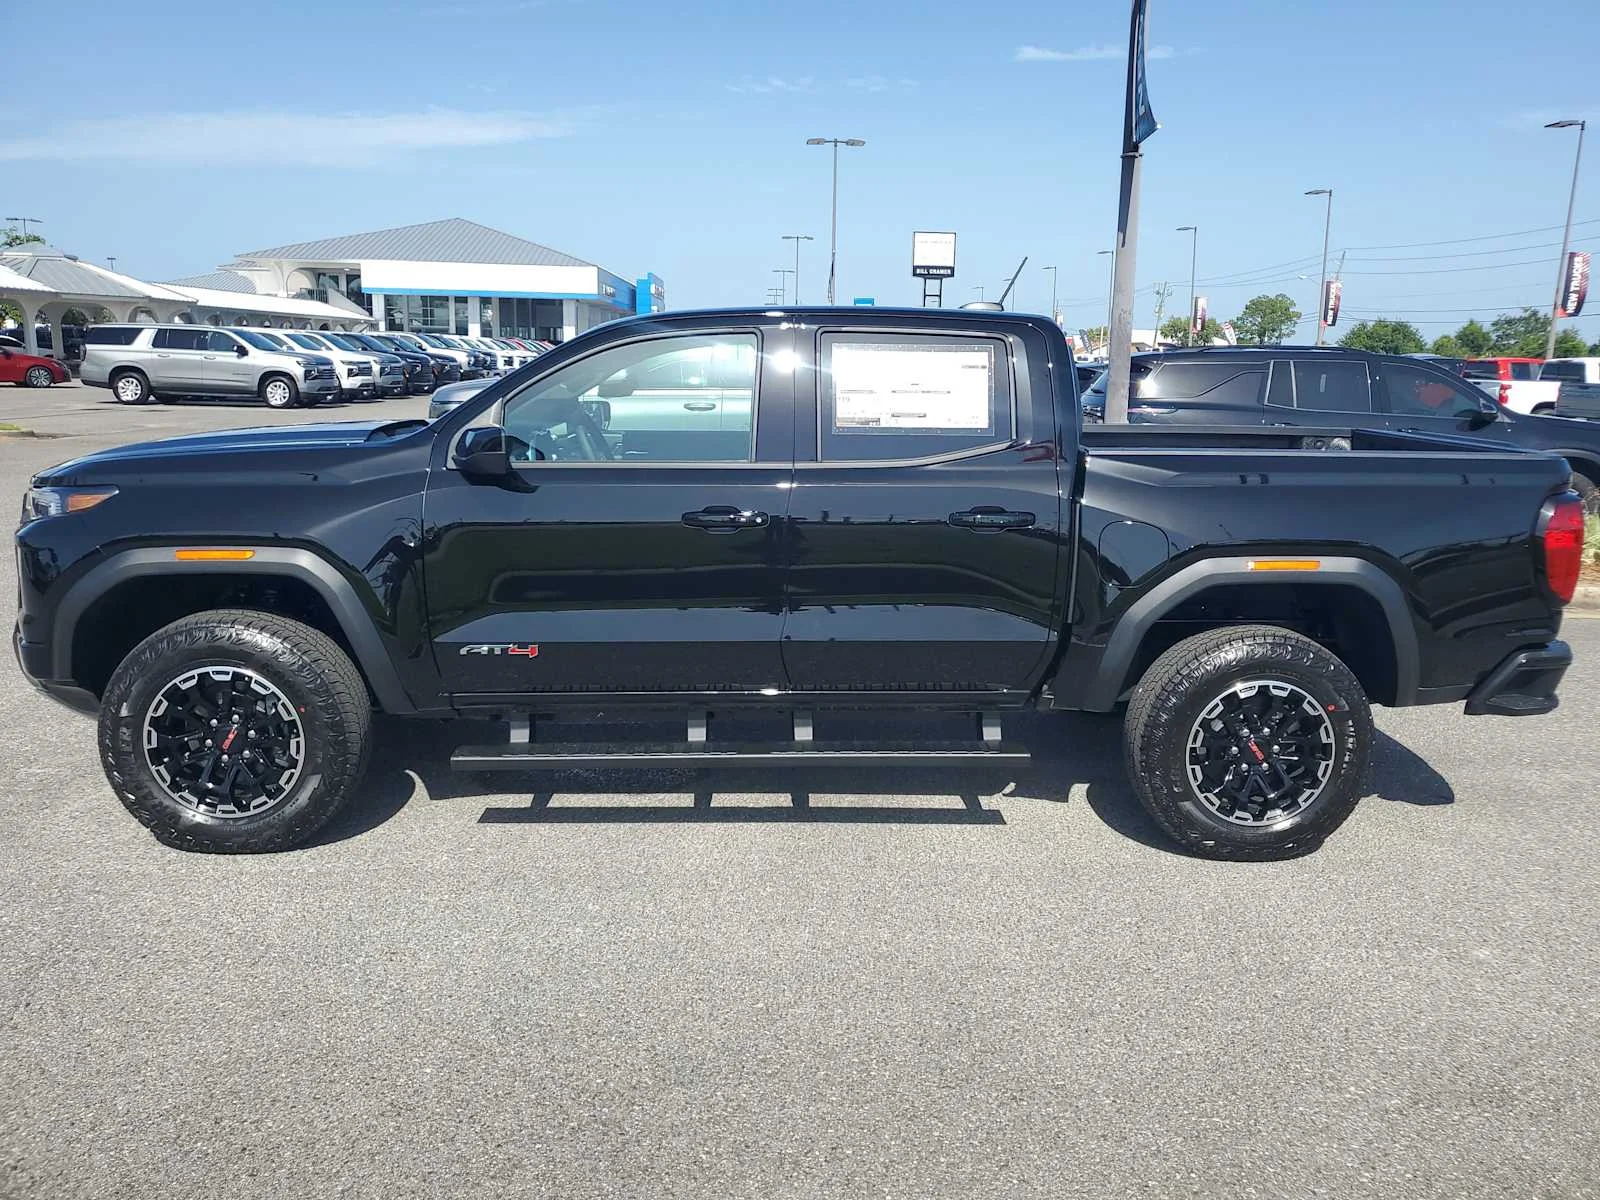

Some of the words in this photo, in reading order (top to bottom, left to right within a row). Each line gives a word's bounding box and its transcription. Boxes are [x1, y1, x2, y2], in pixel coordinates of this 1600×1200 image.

[1569, 256, 1584, 292] TRUCKS
[1565, 293, 1579, 314] NEW
[459, 644, 539, 658] AT4
[222, 727, 238, 750] GMC
[1248, 740, 1265, 761] GMC
